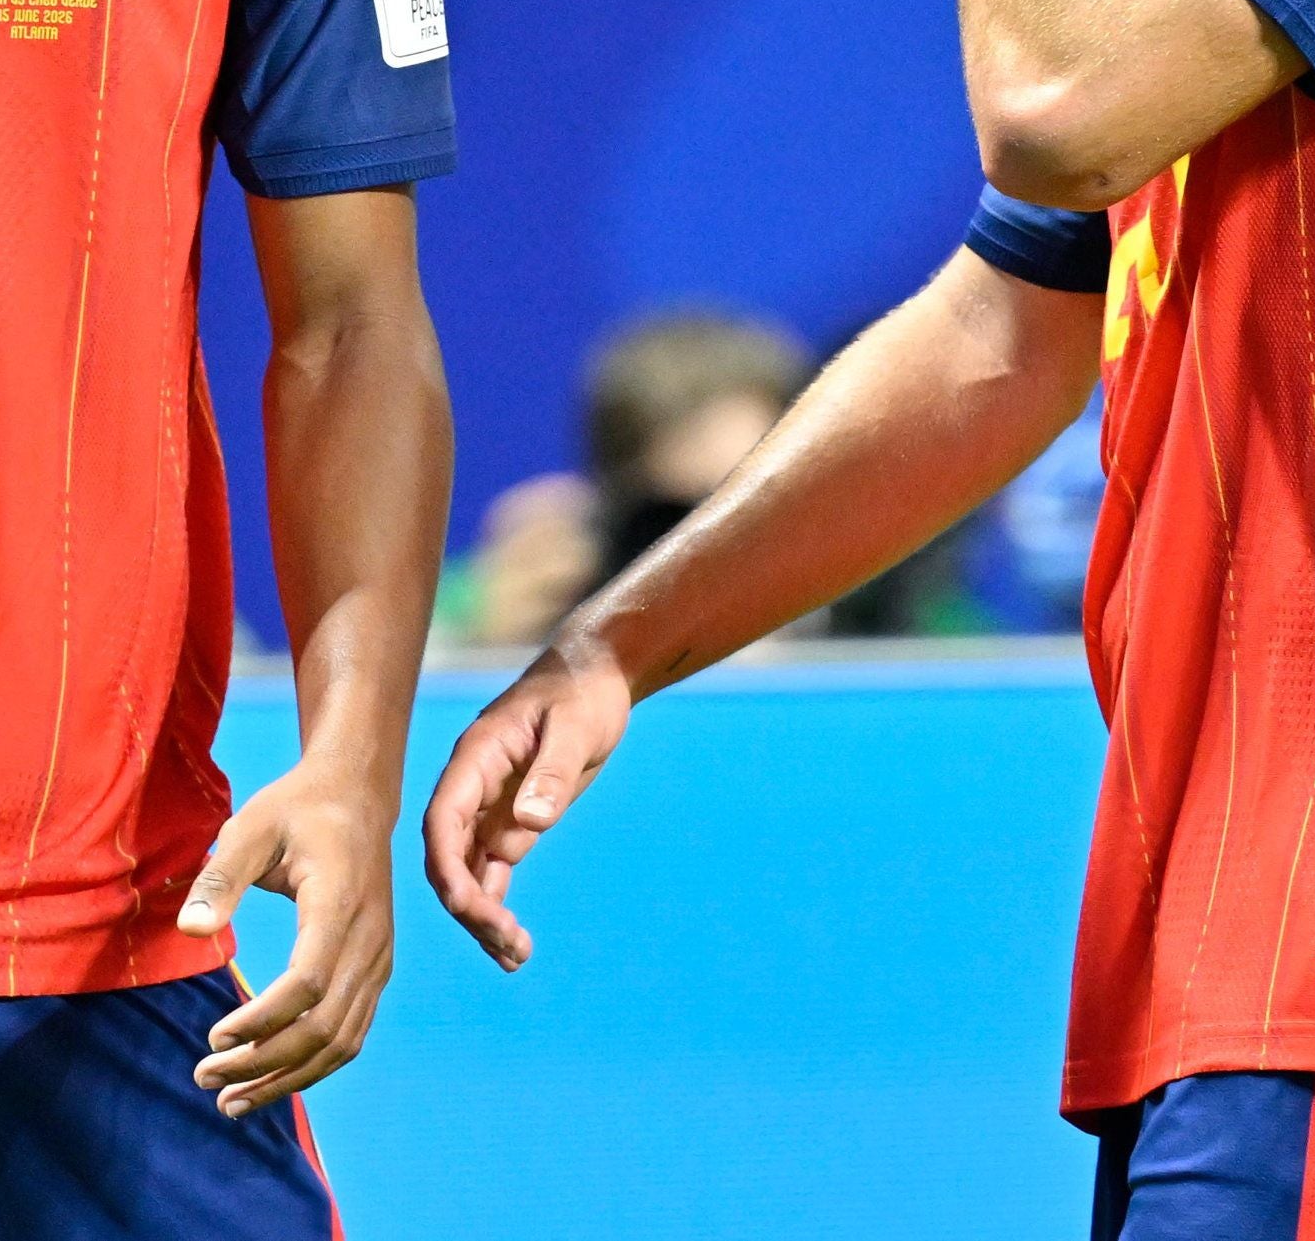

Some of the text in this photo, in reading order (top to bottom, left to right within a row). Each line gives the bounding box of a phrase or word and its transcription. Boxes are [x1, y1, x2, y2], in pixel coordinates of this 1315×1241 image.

[13, 9, 40, 22] JUNE
[43, 10, 73, 23] 2026
[10, 25, 59, 40] ATLANTA
[420, 24, 439, 40] FIFA
